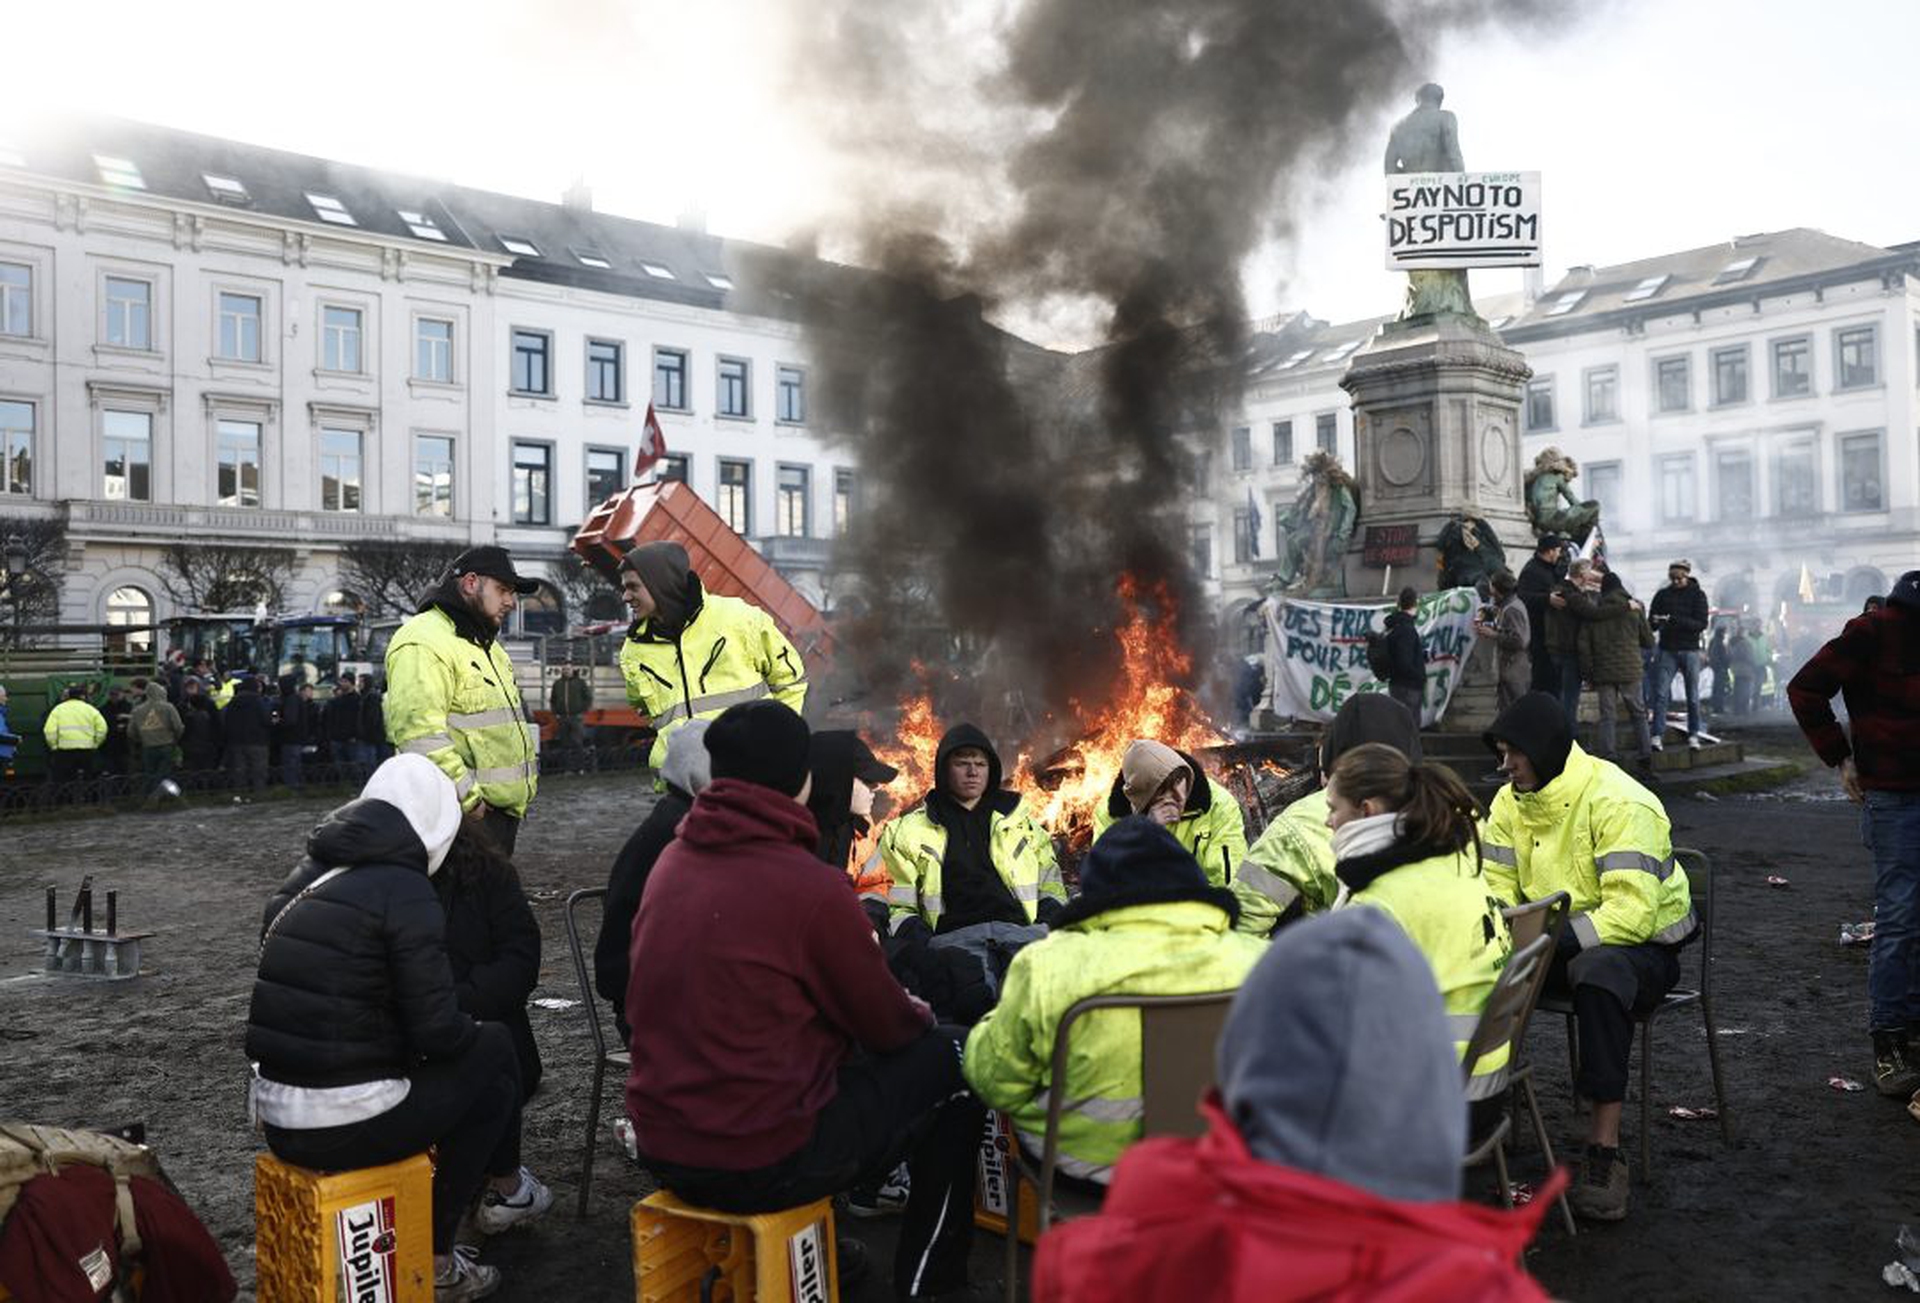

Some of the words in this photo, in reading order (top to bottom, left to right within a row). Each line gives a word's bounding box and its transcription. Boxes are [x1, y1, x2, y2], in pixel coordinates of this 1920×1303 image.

[1284, 605, 1321, 638] DES
[1331, 608, 1375, 637] PRIX
[1287, 635, 1343, 672] POUR
